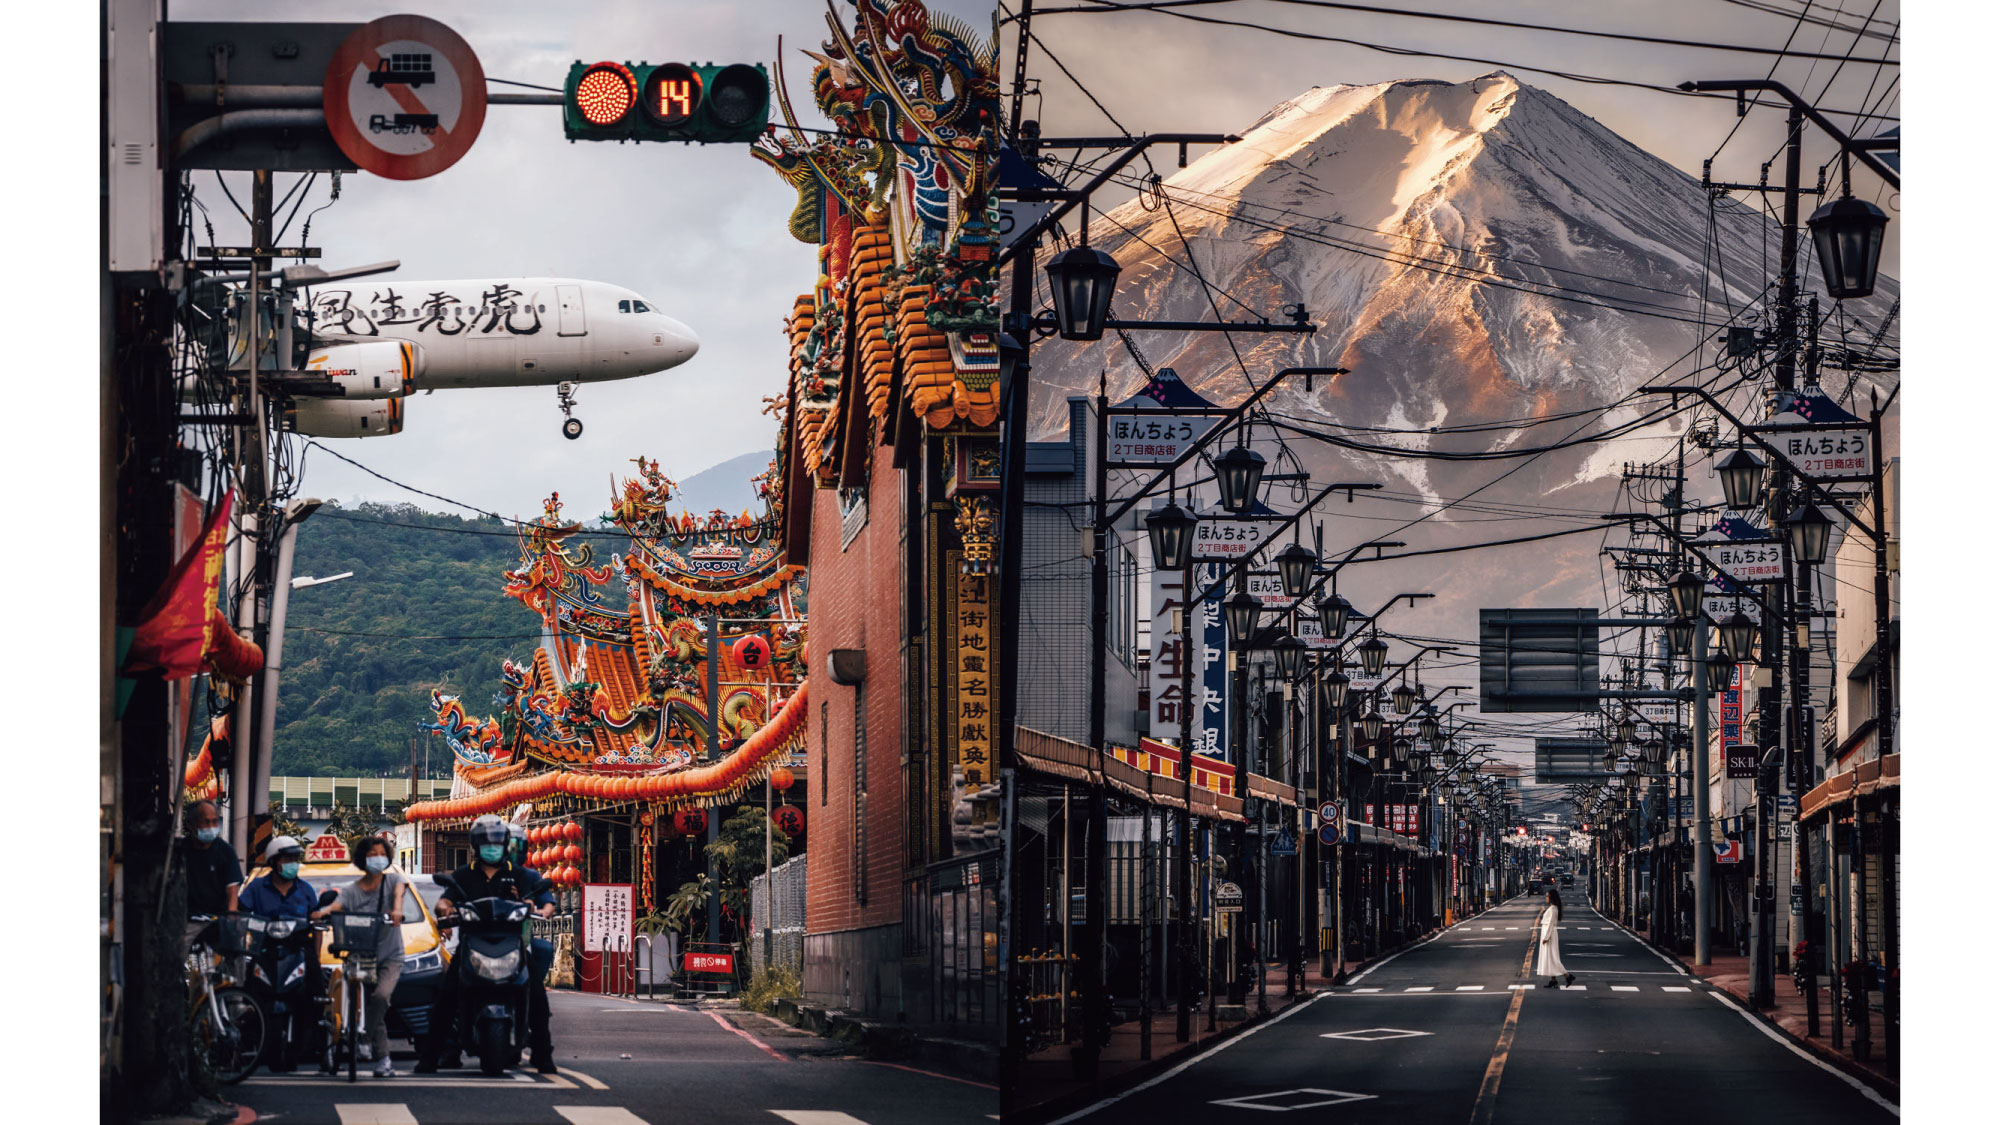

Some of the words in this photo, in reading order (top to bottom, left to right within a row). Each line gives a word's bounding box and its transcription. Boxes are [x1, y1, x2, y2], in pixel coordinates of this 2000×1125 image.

[660, 80, 690, 116] 14
[560, 383, 569, 391] 15
[1115, 421, 1193, 441] ほんちょう
[1114, 444, 1177, 456] 2丁目商店街
[1788, 436, 1864, 456] ほんちょう
[1804, 458, 1865, 471] 2丁目商店街
[1198, 526, 1259, 541] ほんちょう
[1720, 548, 1779, 565] ほんちょう
[1250, 580, 1283, 593] ほんち
[1257, 595, 1292, 603] 丁目商店街
[1709, 601, 1757, 613] ほんちょう
[742, 641, 761, 664] 台
[1323, 807, 1335, 817] 40
[682, 810, 705, 831] 福
[320, 838, 334, 847] M
